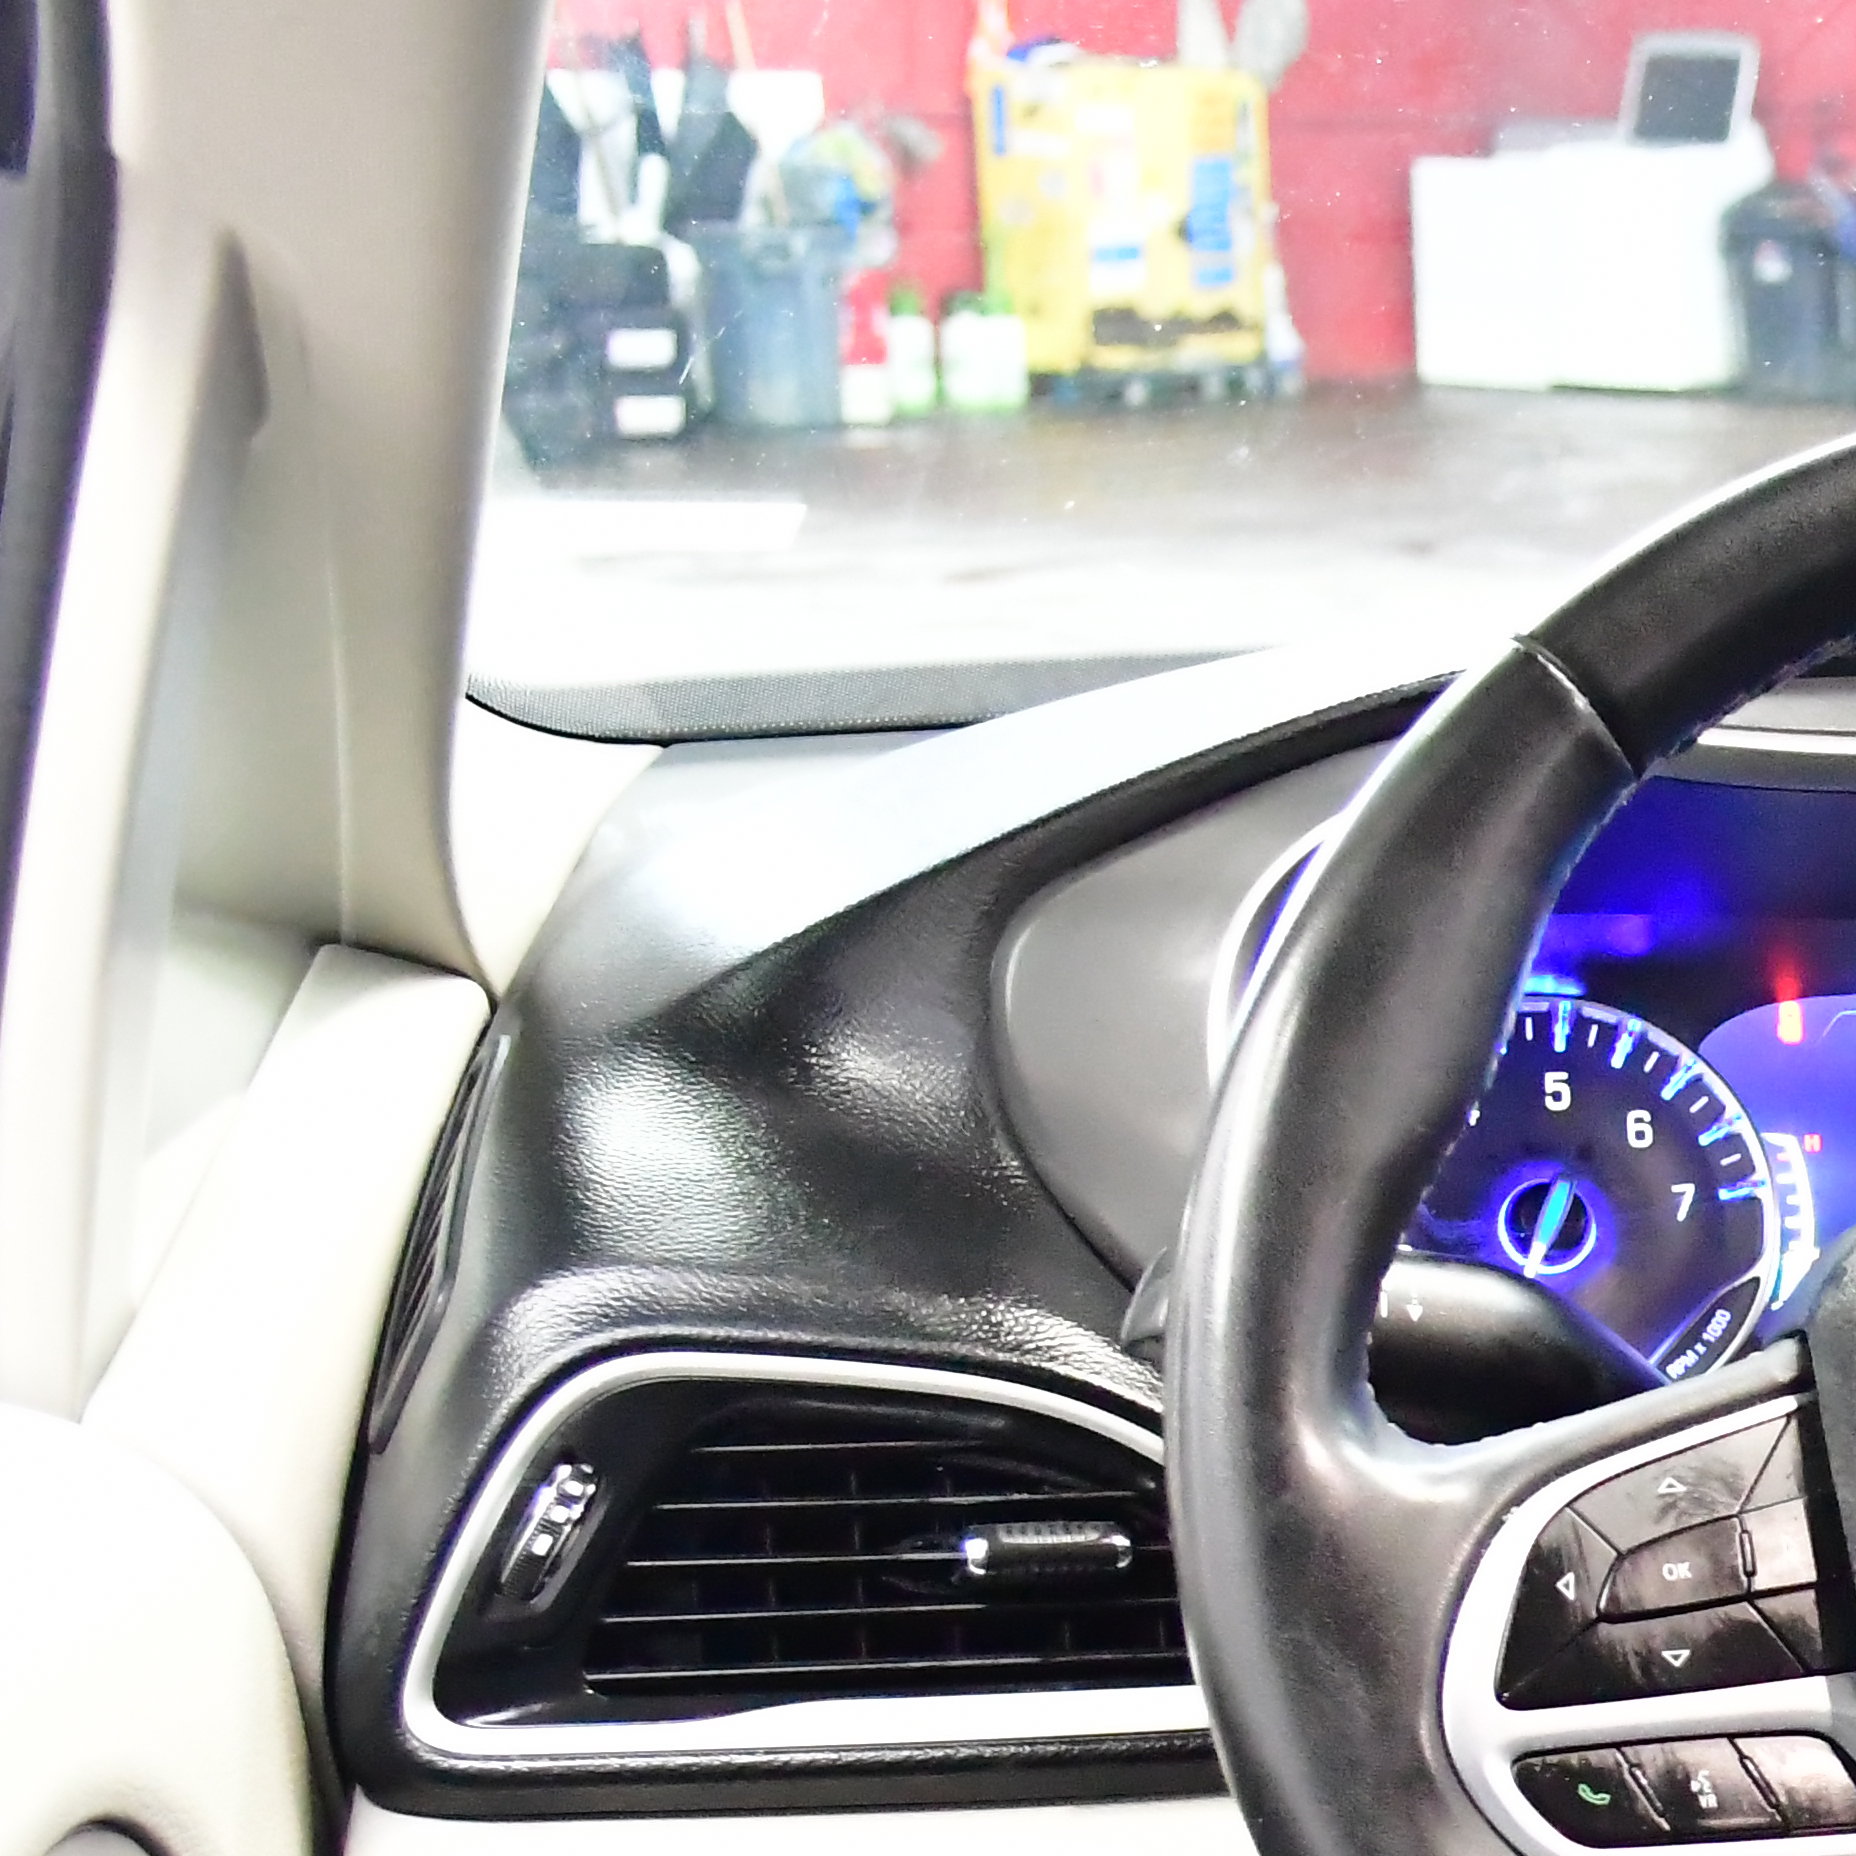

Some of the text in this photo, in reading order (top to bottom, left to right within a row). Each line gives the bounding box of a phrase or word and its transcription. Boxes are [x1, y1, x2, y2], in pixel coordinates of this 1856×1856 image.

[1544, 1071, 1572, 1110] 5
[1626, 1110, 1653, 1149] 6
[1804, 1134, 1822, 1152] H
[1670, 1183, 1696, 1221] 7
[1666, 1349, 1699, 1379] RPM
[1702, 1309, 1731, 1342] 1000
[1662, 1561, 1692, 1581] OK
